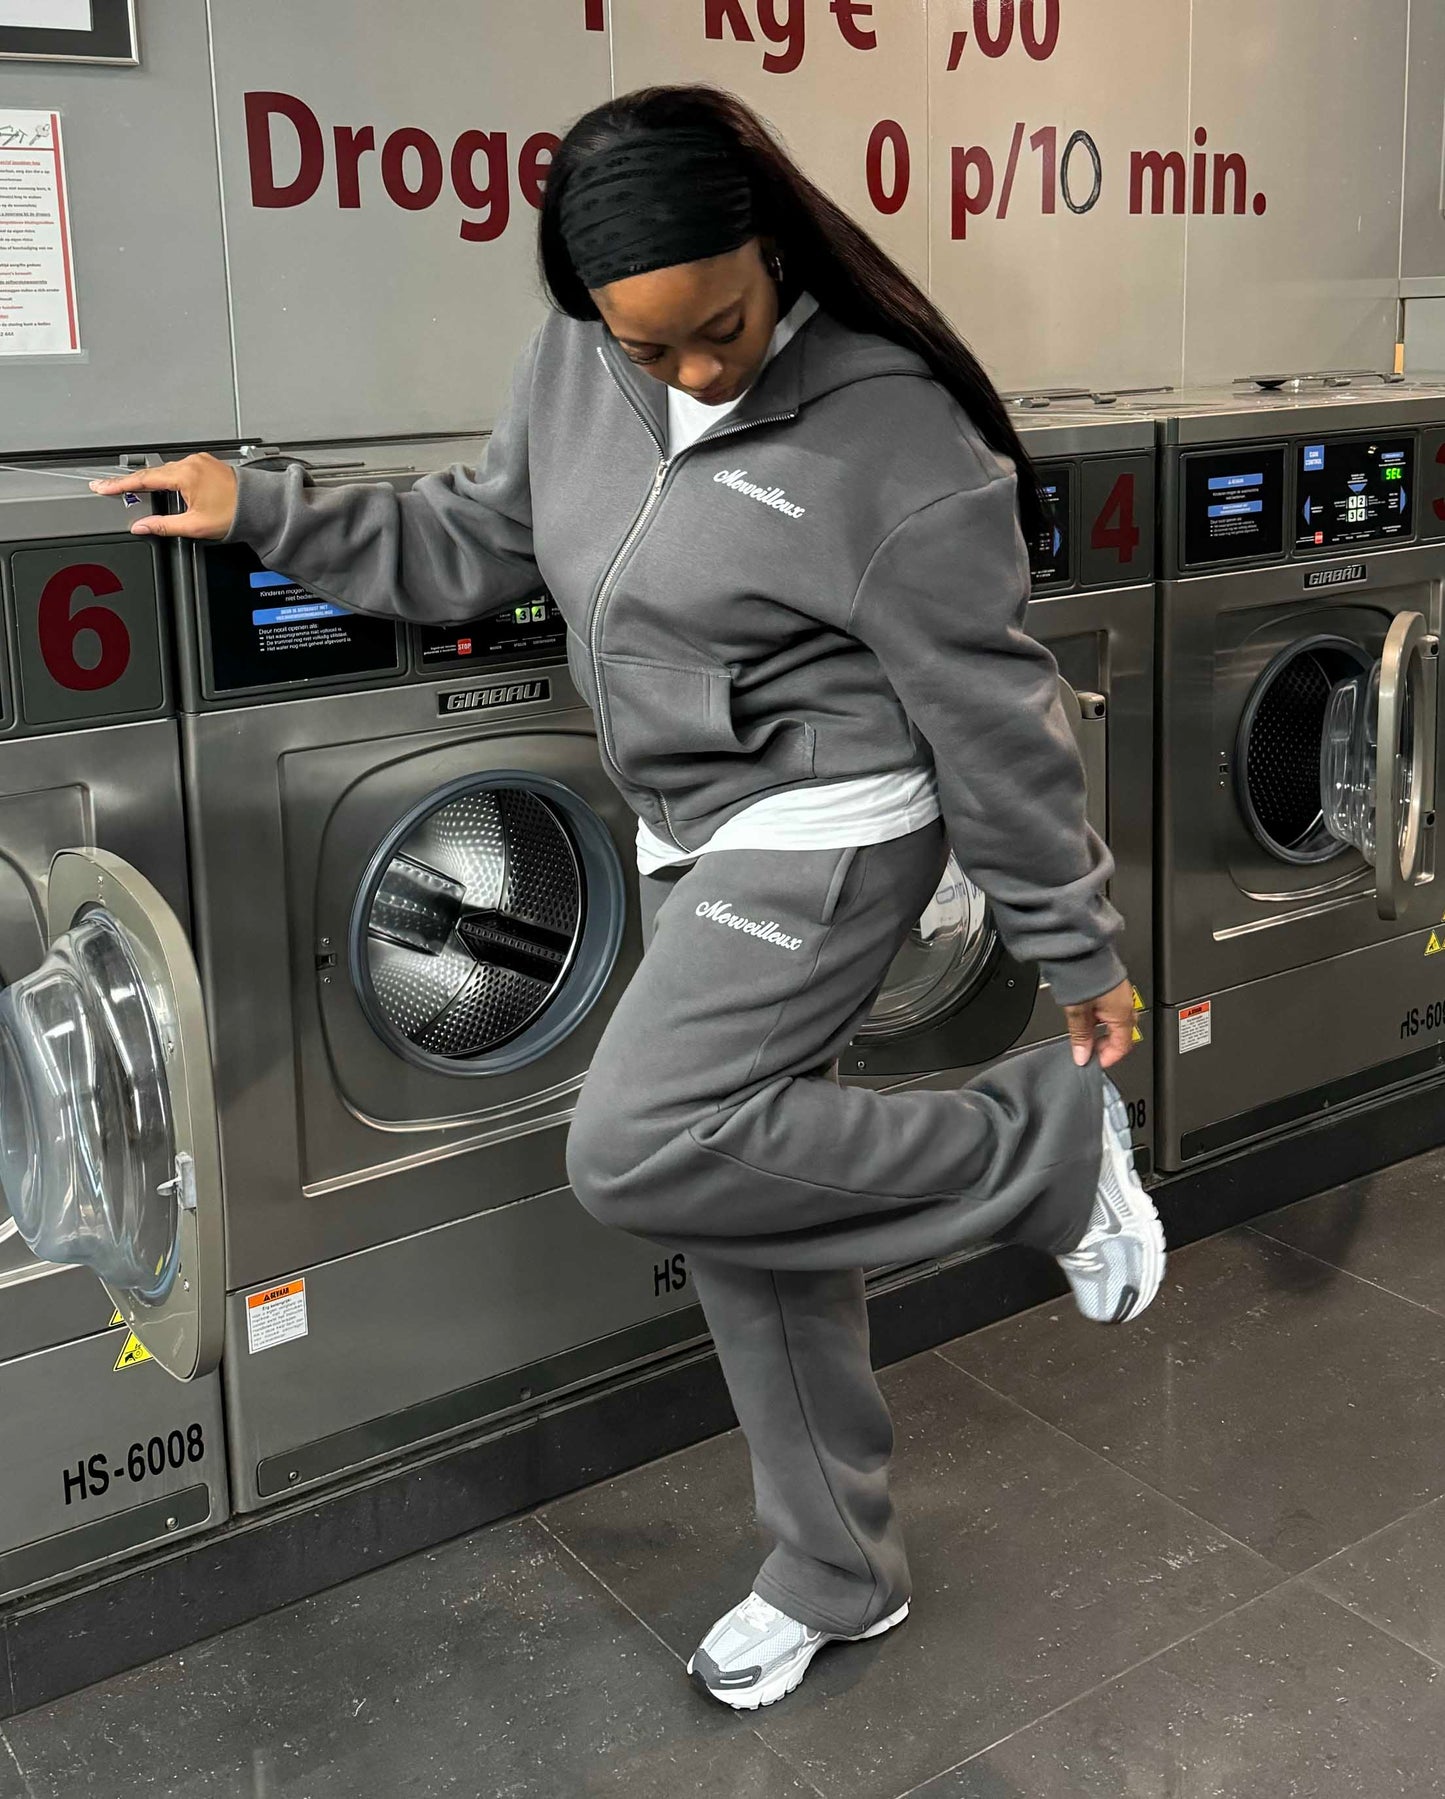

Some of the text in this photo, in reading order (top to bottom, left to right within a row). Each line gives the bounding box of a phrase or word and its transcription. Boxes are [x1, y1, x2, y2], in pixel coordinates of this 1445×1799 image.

[866, 119, 910, 215] 0
[951, 122, 1102, 240] p/10
[1129, 126, 1267, 216] min.
[1091, 472, 1140, 564] 4
[38, 563, 131, 692] 6
[458, 643, 471, 651] STOP
[1400, 1000, 1445, 1040] HS-60
[63, 1423, 205, 1505] HS-6008
